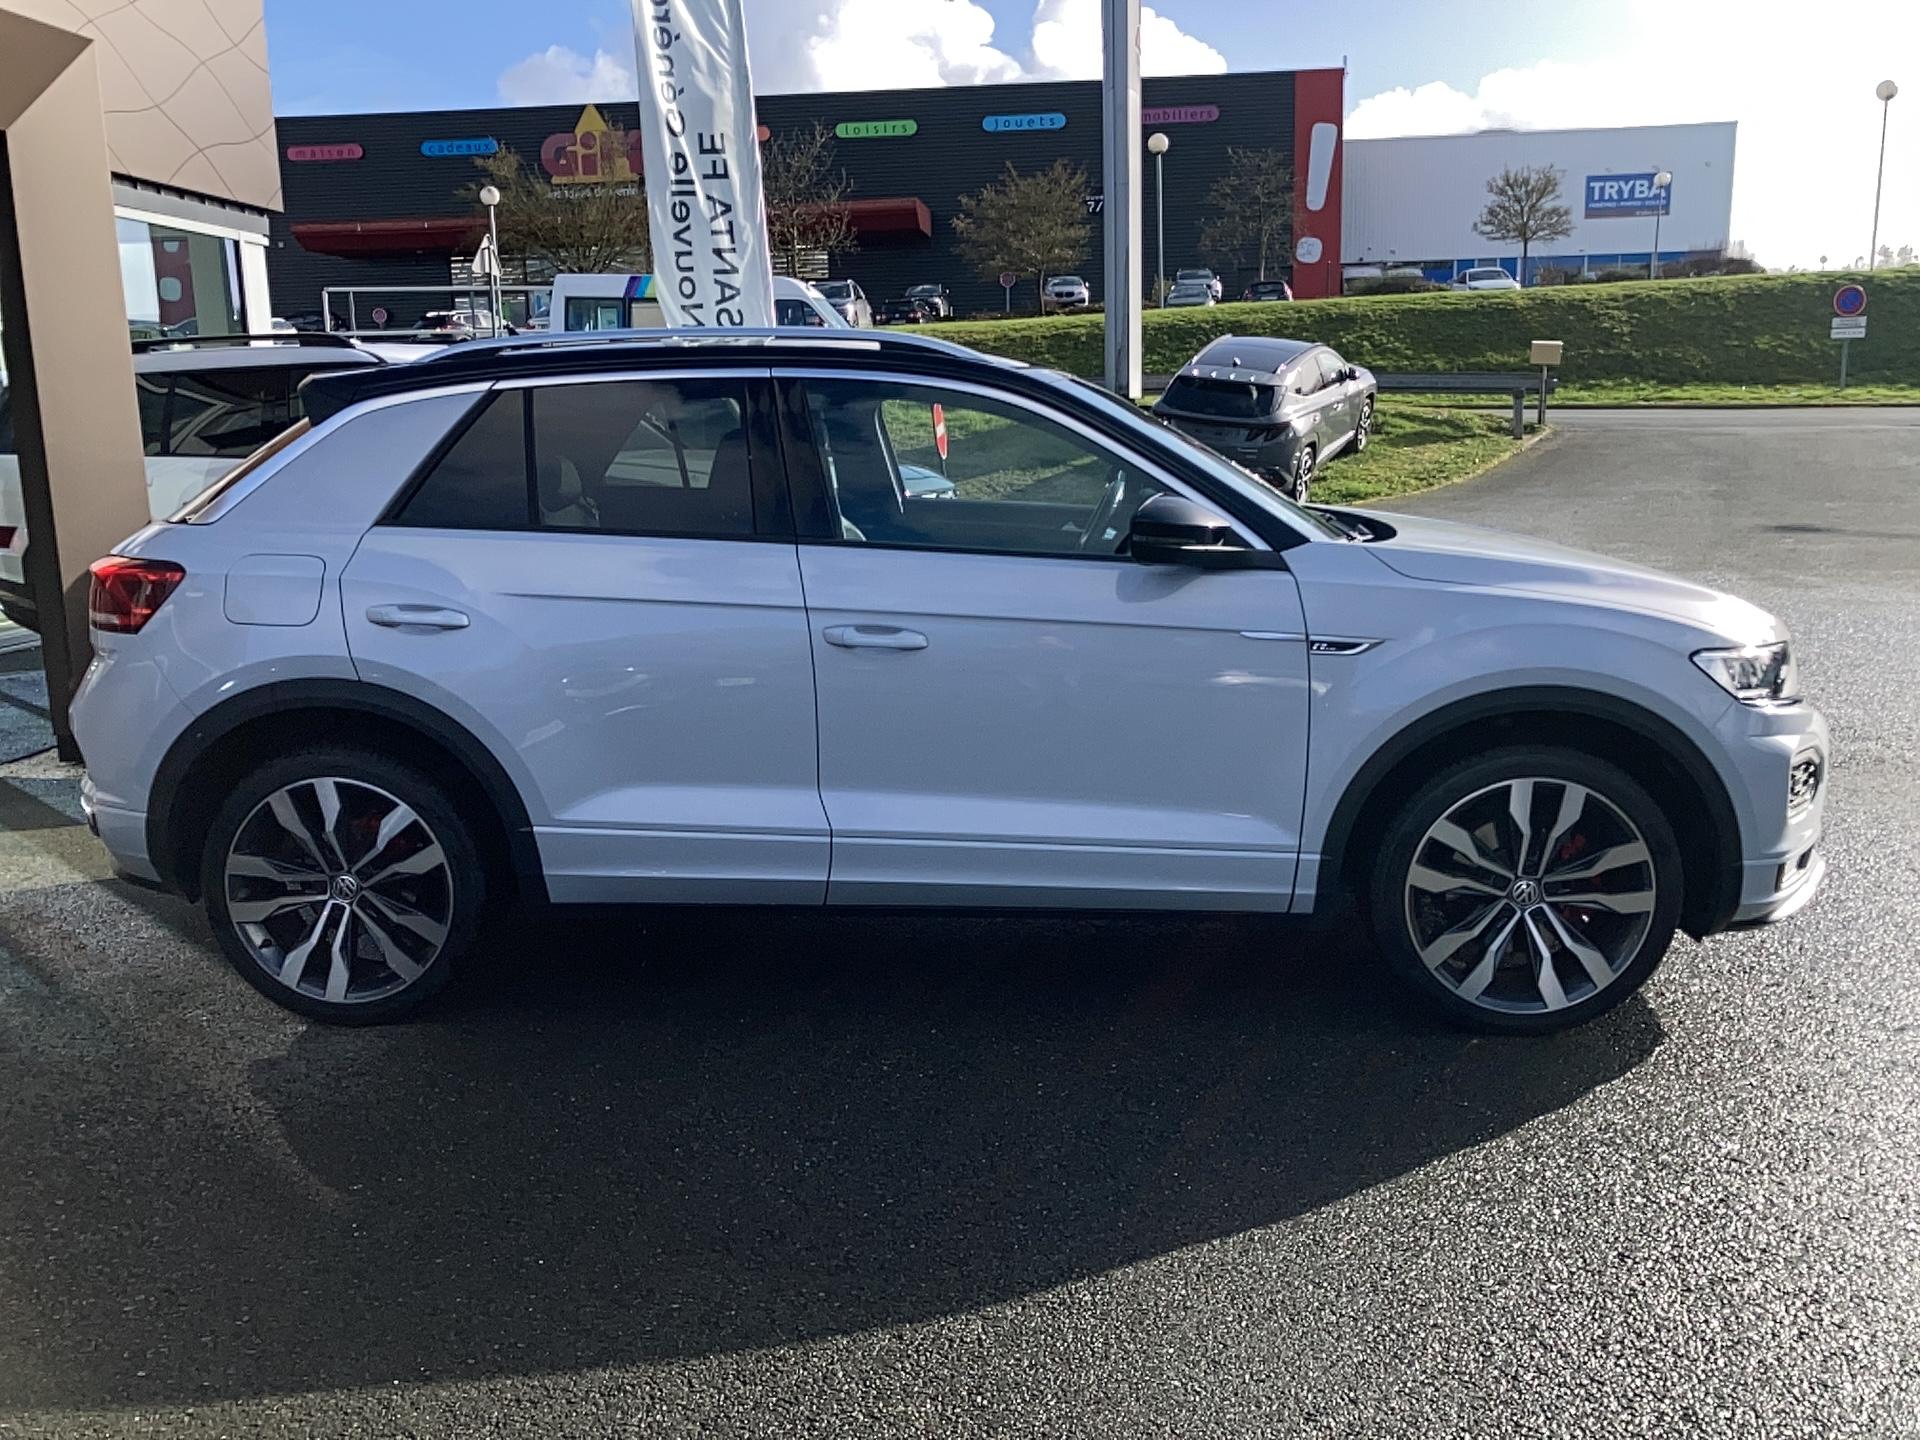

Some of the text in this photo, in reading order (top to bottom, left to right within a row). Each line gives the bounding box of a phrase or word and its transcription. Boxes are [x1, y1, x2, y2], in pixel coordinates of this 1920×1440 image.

[994, 116, 1056, 129] jouets
[844, 123, 908, 136] loisirs
[294, 148, 355, 159] maison
[428, 142, 490, 153] cadeaux
[1589, 180, 1667, 201] TRYBA
